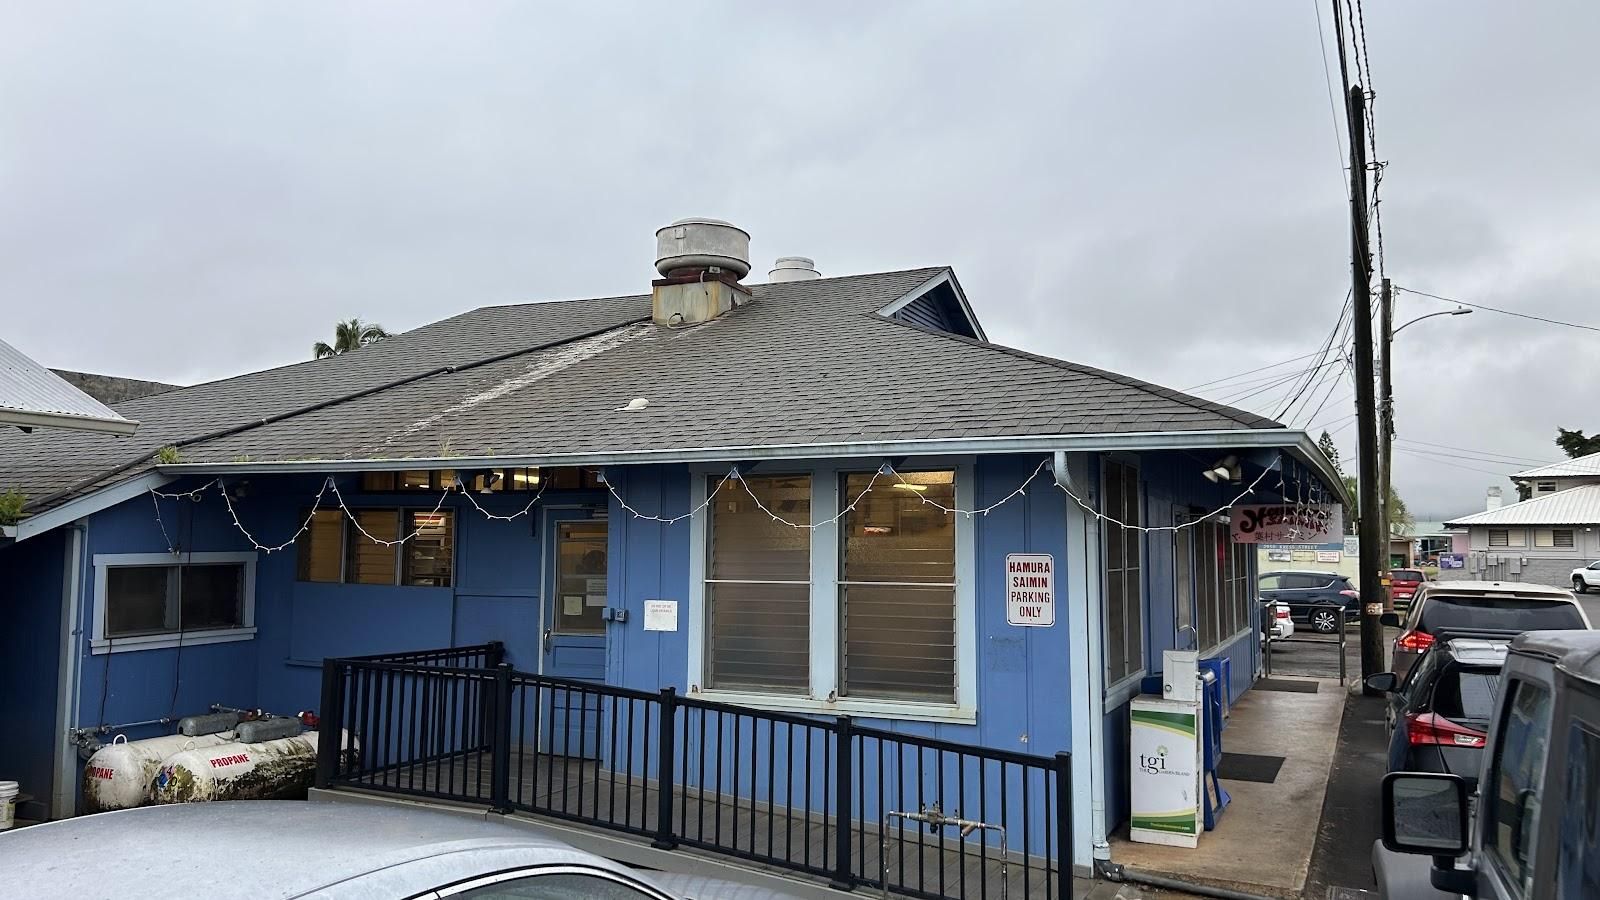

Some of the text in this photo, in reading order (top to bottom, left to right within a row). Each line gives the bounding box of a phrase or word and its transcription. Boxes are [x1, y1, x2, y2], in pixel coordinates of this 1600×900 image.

[1009, 562, 1050, 573] HAMURA
[1013, 577, 1047, 588] SAIMIN
[1011, 592, 1050, 603] PARKING
[1019, 606, 1042, 617] ONLY
[210, 754, 250, 768] PROPANE
[1139, 752, 1166, 775] tgi
